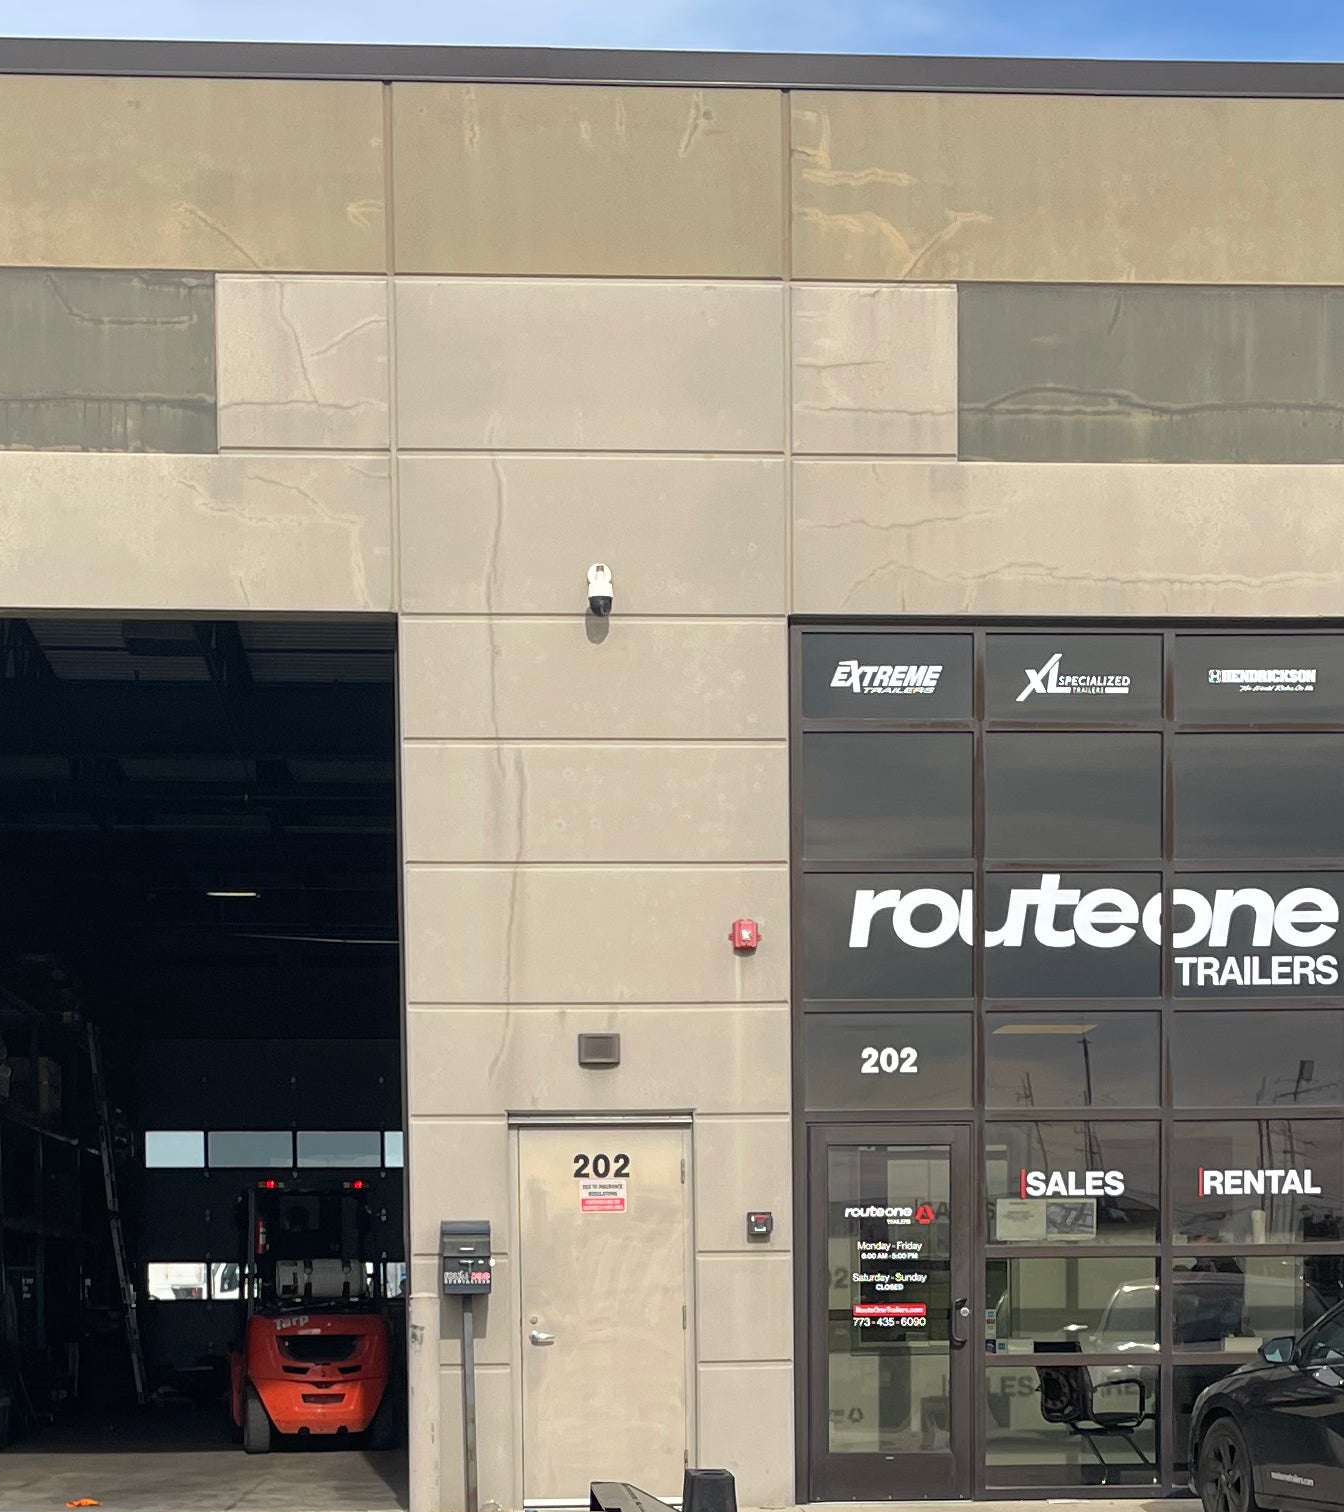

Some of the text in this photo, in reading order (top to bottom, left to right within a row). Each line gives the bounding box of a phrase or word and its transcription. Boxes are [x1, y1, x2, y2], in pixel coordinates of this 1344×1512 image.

[830, 660, 943, 693] EXTREME
[1016, 653, 1131, 701] XL SPECIALIZED
[1222, 669, 1316, 683] HENDRICKSON
[848, 873, 1339, 949] routeone
[1175, 955, 1339, 987] TRAILERS
[860, 1047, 918, 1073] 202
[573, 1153, 630, 1178] 202
[1026, 1171, 1125, 1197] SALES
[1204, 1169, 1321, 1195] RENTAL
[844, 1205, 913, 1218] routeone
[857, 1241, 891, 1251] Monday
[896, 1241, 922, 1251] Friday
[852, 1272, 890, 1283] Saturday
[895, 1272, 927, 1283] Sunday
